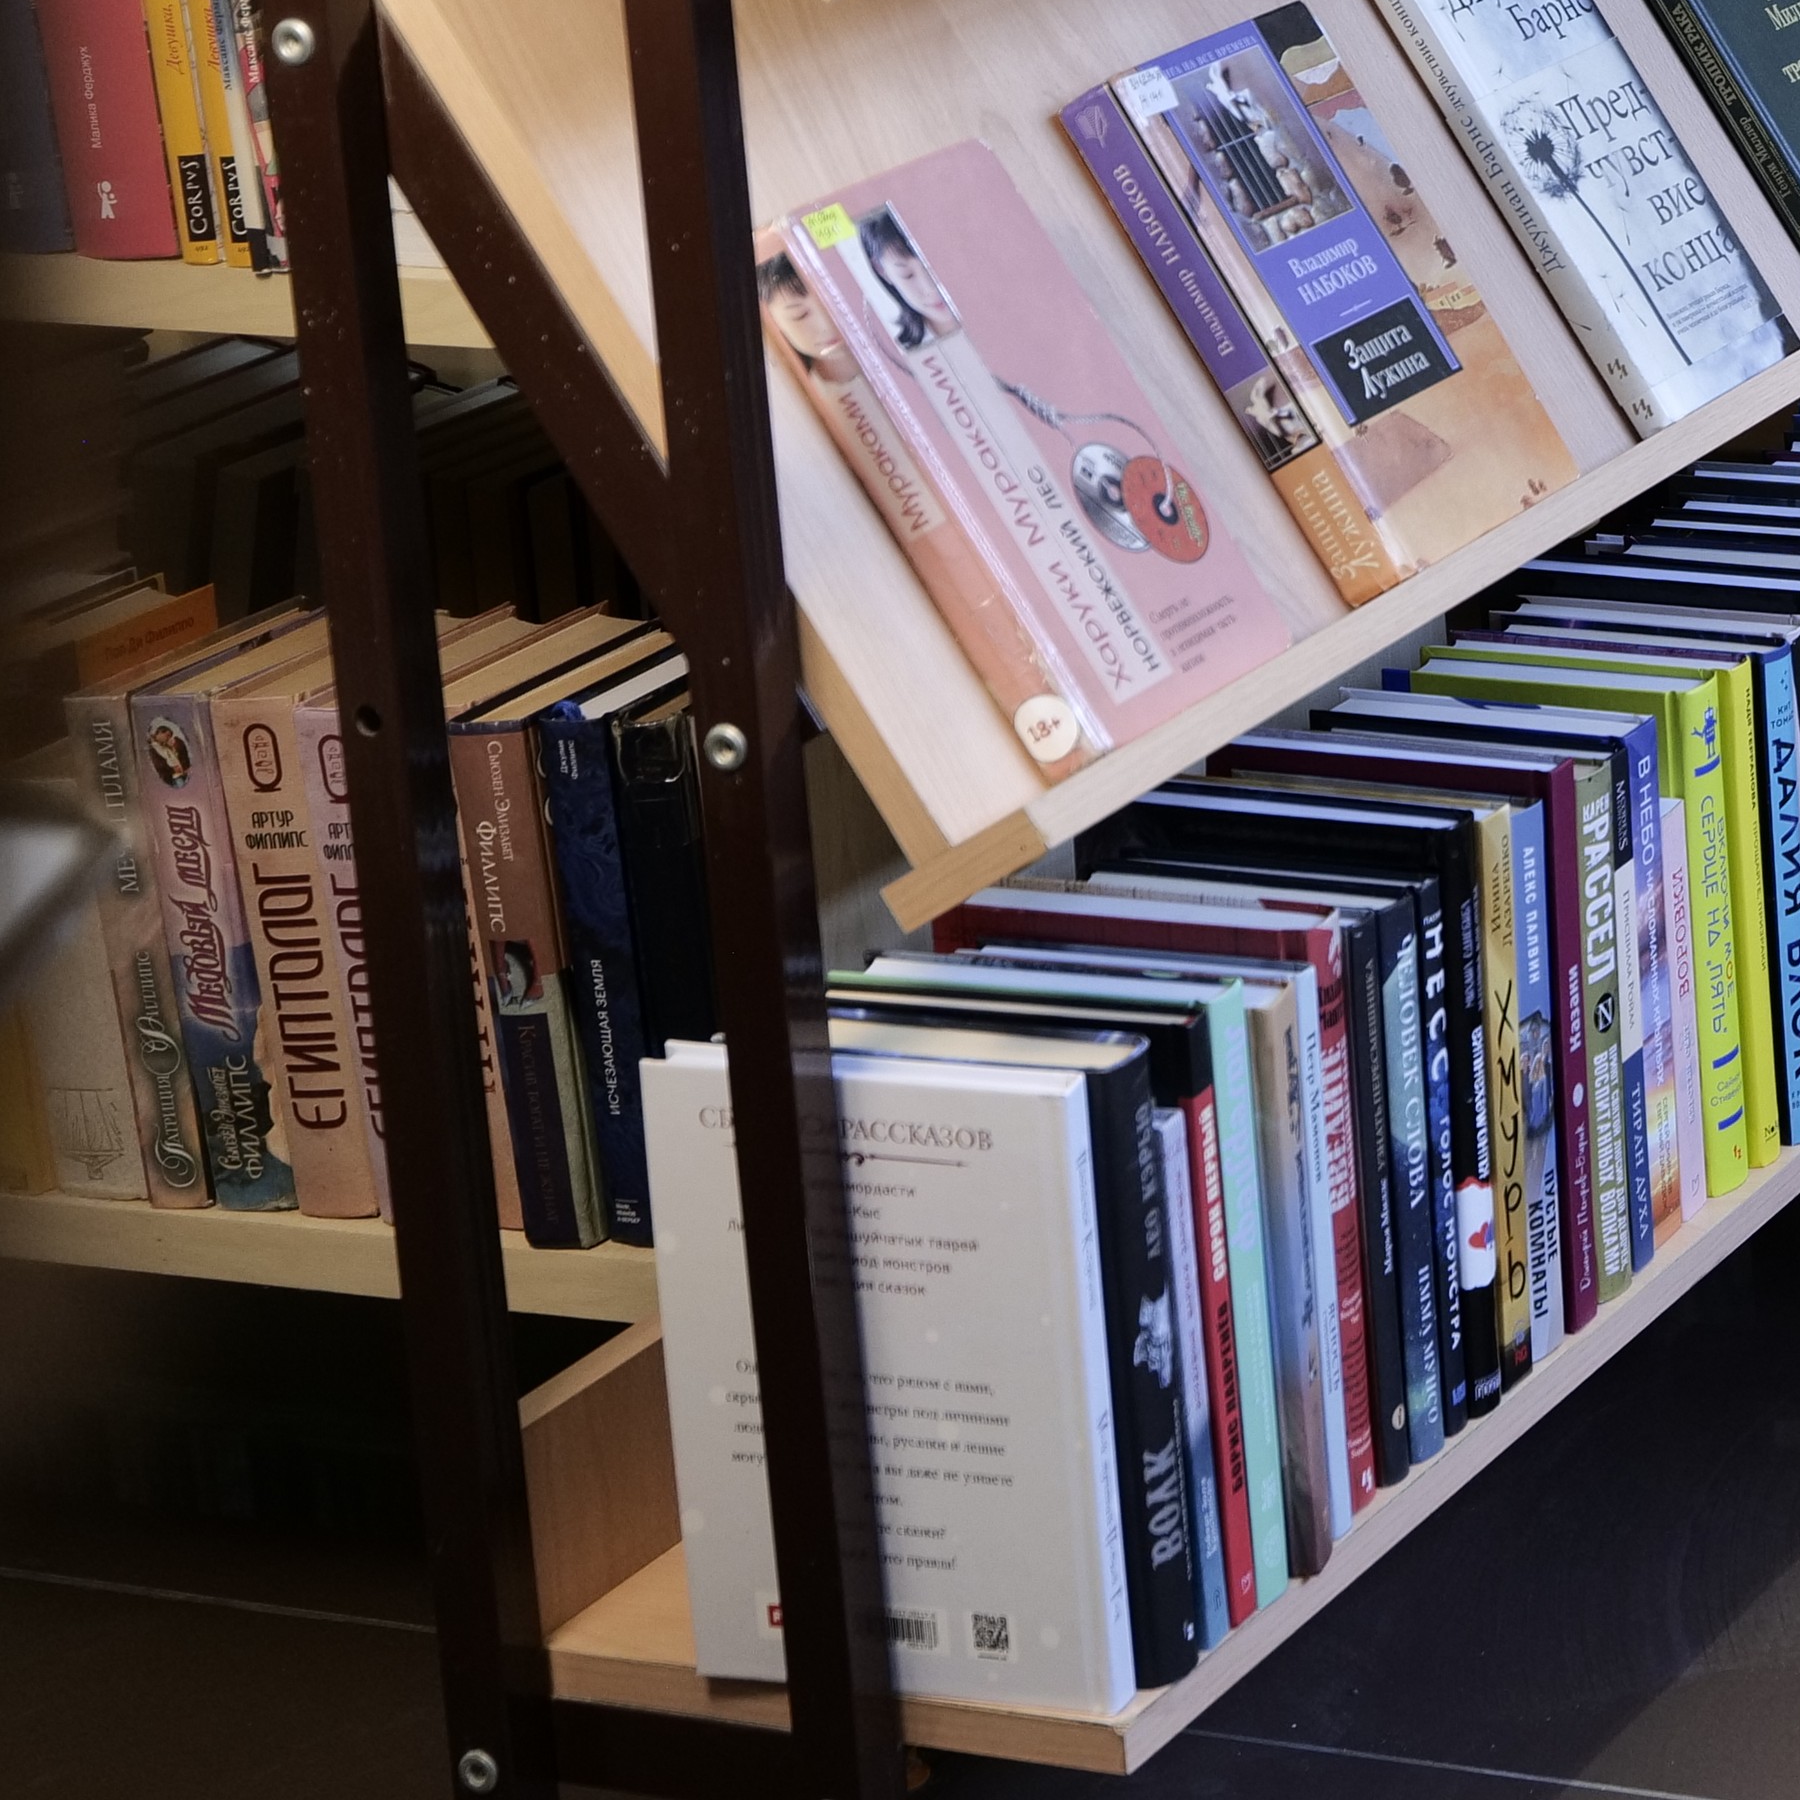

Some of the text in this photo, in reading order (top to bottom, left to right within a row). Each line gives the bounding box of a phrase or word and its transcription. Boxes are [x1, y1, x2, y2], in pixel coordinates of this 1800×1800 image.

[1672, 3, 1737, 108] ТРОПИК РАКА
[87, 98, 104, 150] Малика
[1460, 115, 1565, 274] Джулиан Барнс
[1648, 176, 1710, 228] вие
[1287, 233, 1360, 279] Владимир
[1297, 252, 1379, 306] НАБОКОВ
[1639, 220, 1738, 293] конца
[1342, 322, 1414, 371] Защита
[1362, 350, 1431, 400] Лужина
[836, 391, 930, 534] Мураками
[920, 355, 1135, 692] Харуки Мураками
[1023, 464, 1161, 673] НОРВЕЖСКИЙ ЛЕС
[244, 827, 310, 850] ФИЛЛИПС
[250, 811, 296, 829] АРТУР
[1640, 787, 1655, 868] НЕБО
[1522, 846, 1540, 985] АЛЕКС ПАЛВИН
[1582, 818, 1617, 985] РАССЕЛ
[251, 862, 349, 1130] ЕГИПТОЛОГ
[589, 958, 624, 1117] ИСЧЕЗАЮЩАЯ ЗЕМЛЯ
[1396, 930, 1427, 1211] ЧЕЛОВЕК СЛОВА
[1308, 1080, 1322, 1183] Мамонов
[1629, 1082, 1649, 1242] ТИРАН ДУХА
[1143, 1208, 1163, 1263] ЛЕО
[1439, 1114, 1462, 1351] ГОЛОС МОНСТРА
[1528, 1199, 1549, 1319] КОМНАТЫ
[1544, 1169, 1558, 1263] ПУСТЫЕ
[1600, 1188, 1621, 1277] ВОЛКАМИ
[1199, 1103, 1246, 1497] БОРИС СОРОК ПЕРВЫЙ
[1328, 1302, 1341, 1392] ЯСНОСТЬ
[1142, 1435, 1185, 1573] ВОЛК
